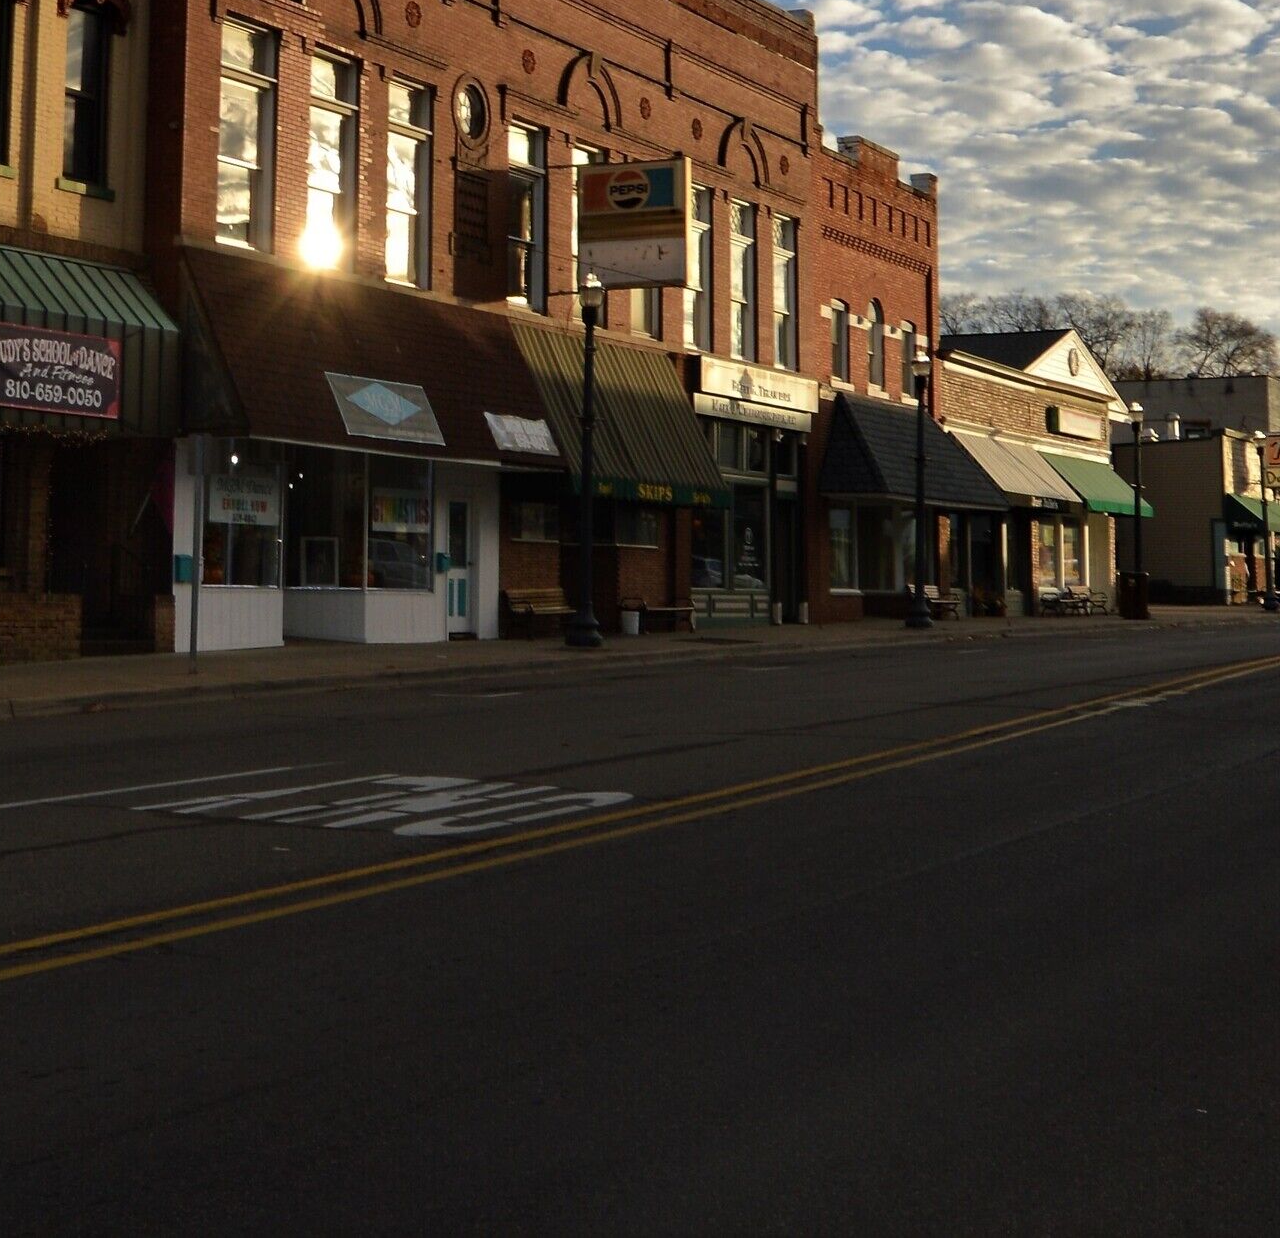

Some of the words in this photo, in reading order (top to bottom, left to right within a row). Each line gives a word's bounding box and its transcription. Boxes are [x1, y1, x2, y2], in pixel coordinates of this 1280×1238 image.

[609, 183, 648, 196] PEPSI
[32, 338, 72, 366] SCHOOL
[80, 346, 115, 380] DANCE
[19, 363, 49, 380] And
[51, 365, 95, 386] Fitness
[4, 379, 102, 408] 810-659-0050
